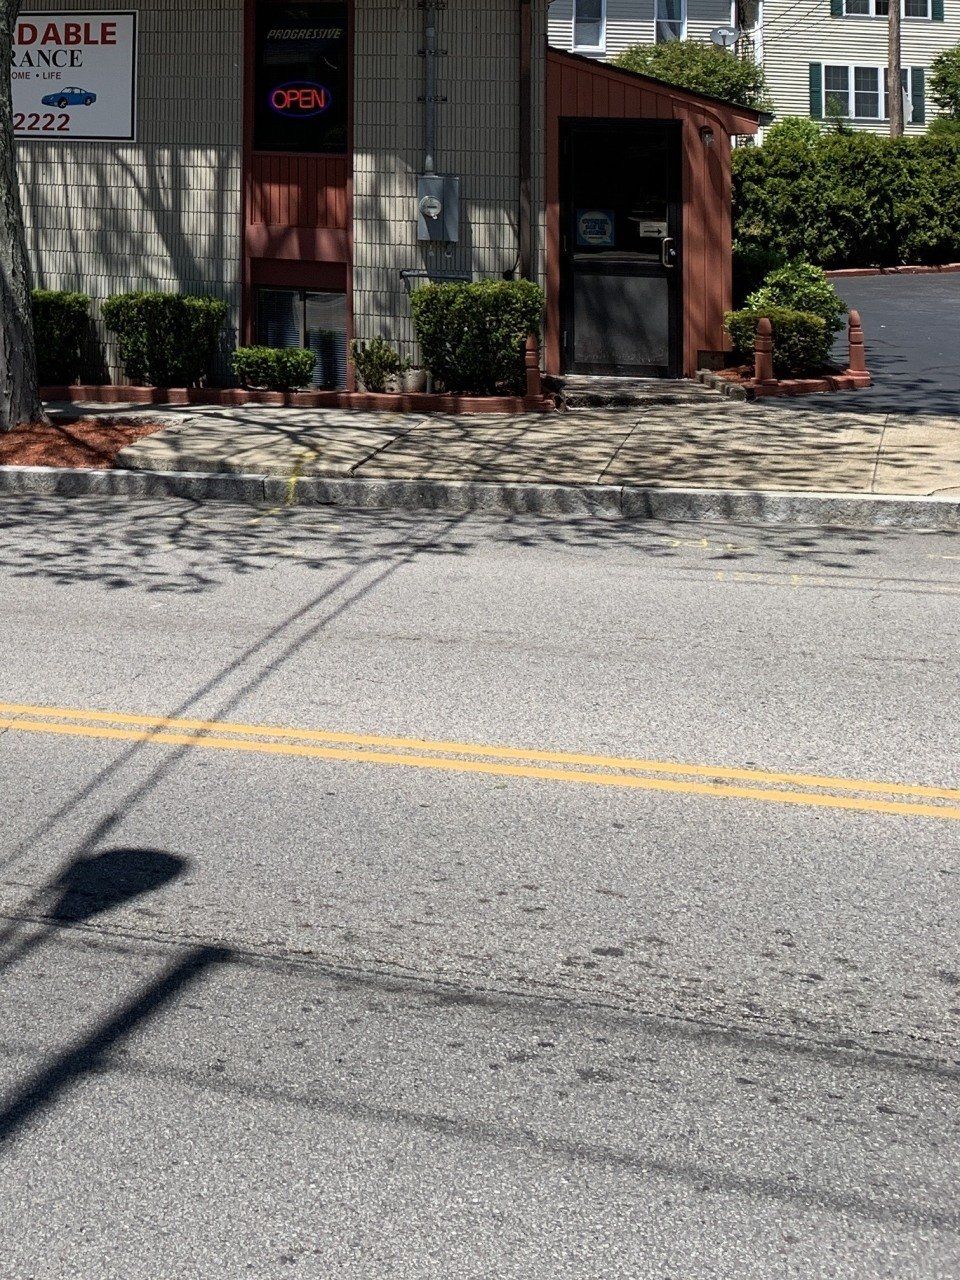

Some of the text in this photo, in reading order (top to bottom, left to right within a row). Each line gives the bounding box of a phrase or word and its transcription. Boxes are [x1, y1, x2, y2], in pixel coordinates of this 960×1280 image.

[267, 28, 343, 40] PROGRESSIVE
[11, 71, 62, 80] OME LIFE
[271, 88, 326, 109] OPEN
